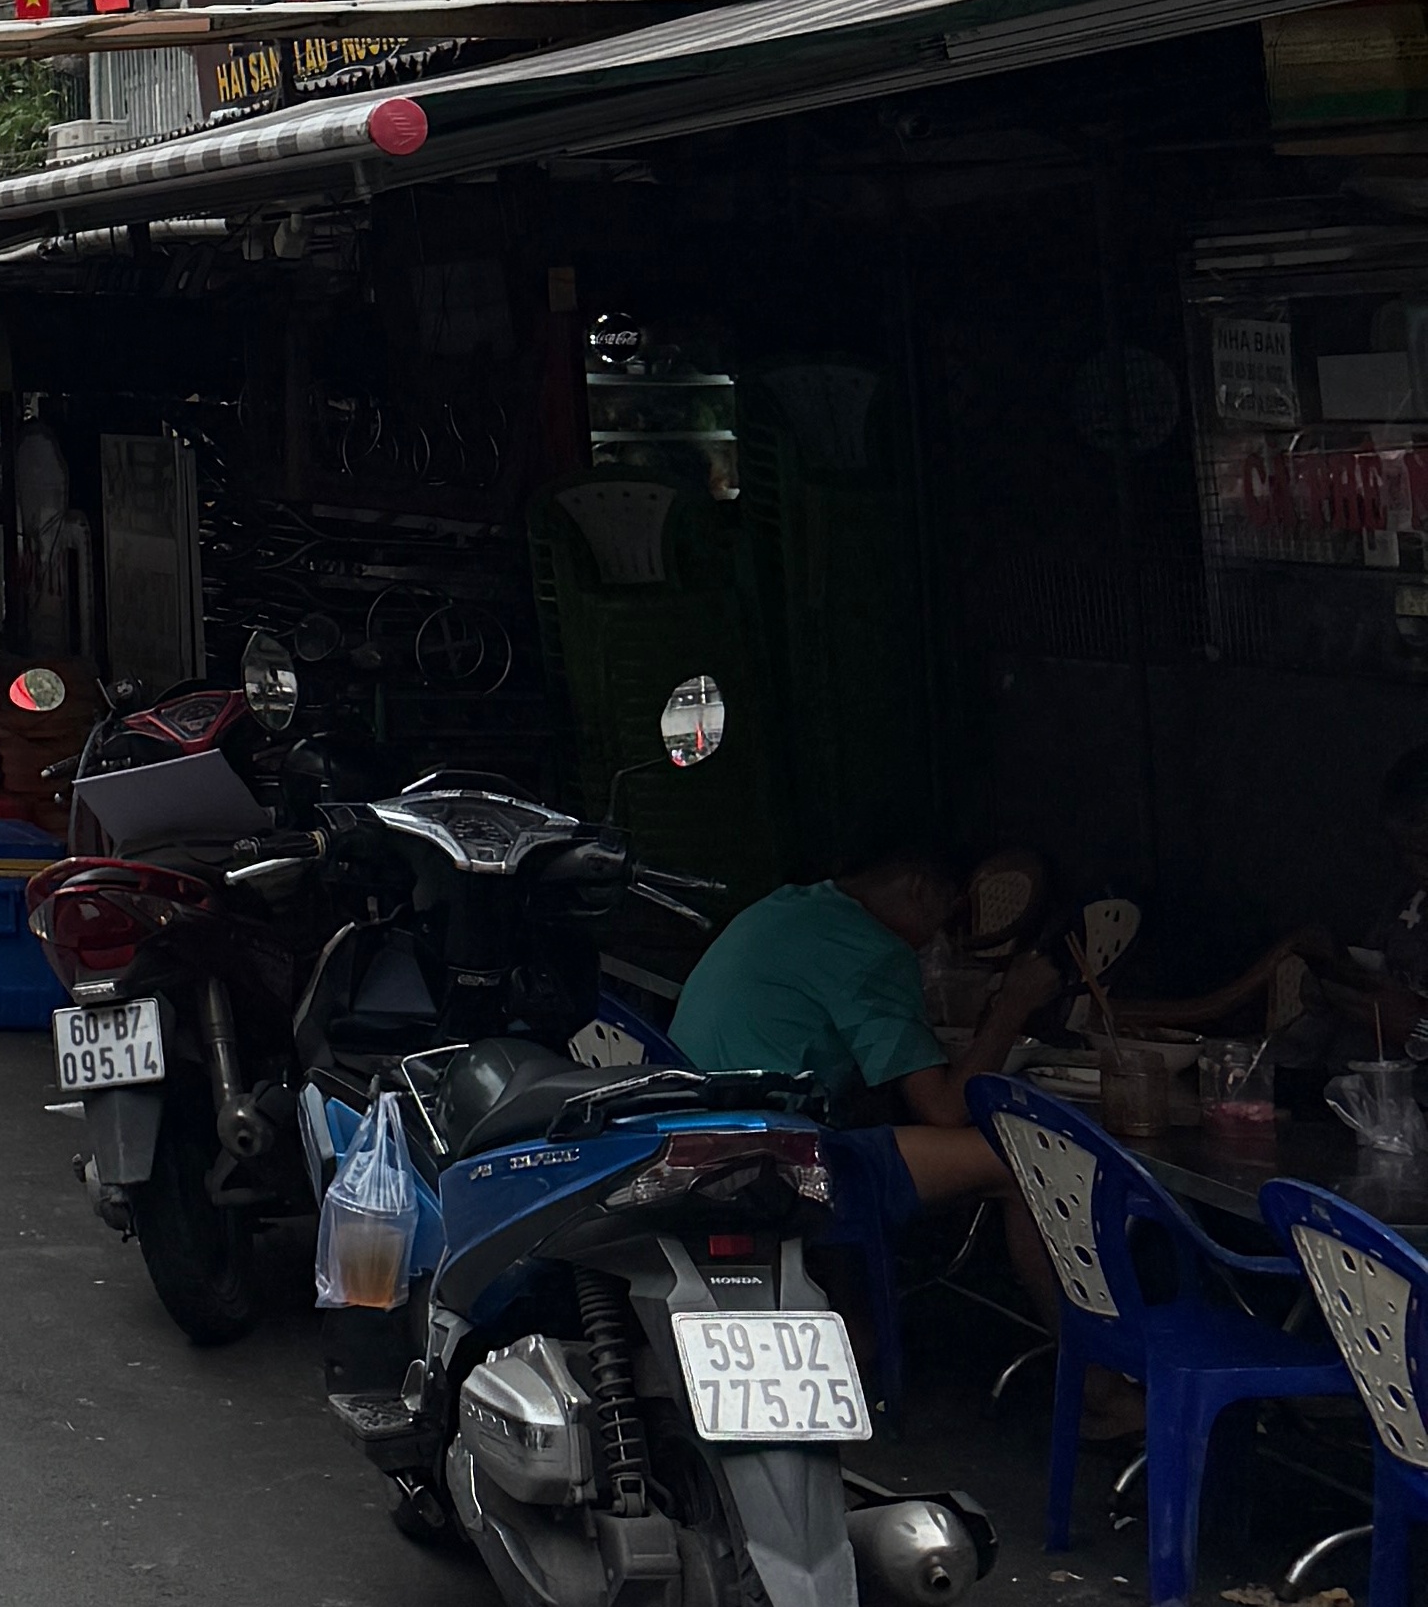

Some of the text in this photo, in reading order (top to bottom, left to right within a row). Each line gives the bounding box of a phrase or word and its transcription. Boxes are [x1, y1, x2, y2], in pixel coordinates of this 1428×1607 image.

[70, 1005, 141, 1046] 60-B7
[63, 1041, 158, 1085] 095.14
[710, 1276, 762, 1285] HONDA
[701, 1322, 829, 1371] 59-D2
[699, 1379, 857, 1429] 775.25
